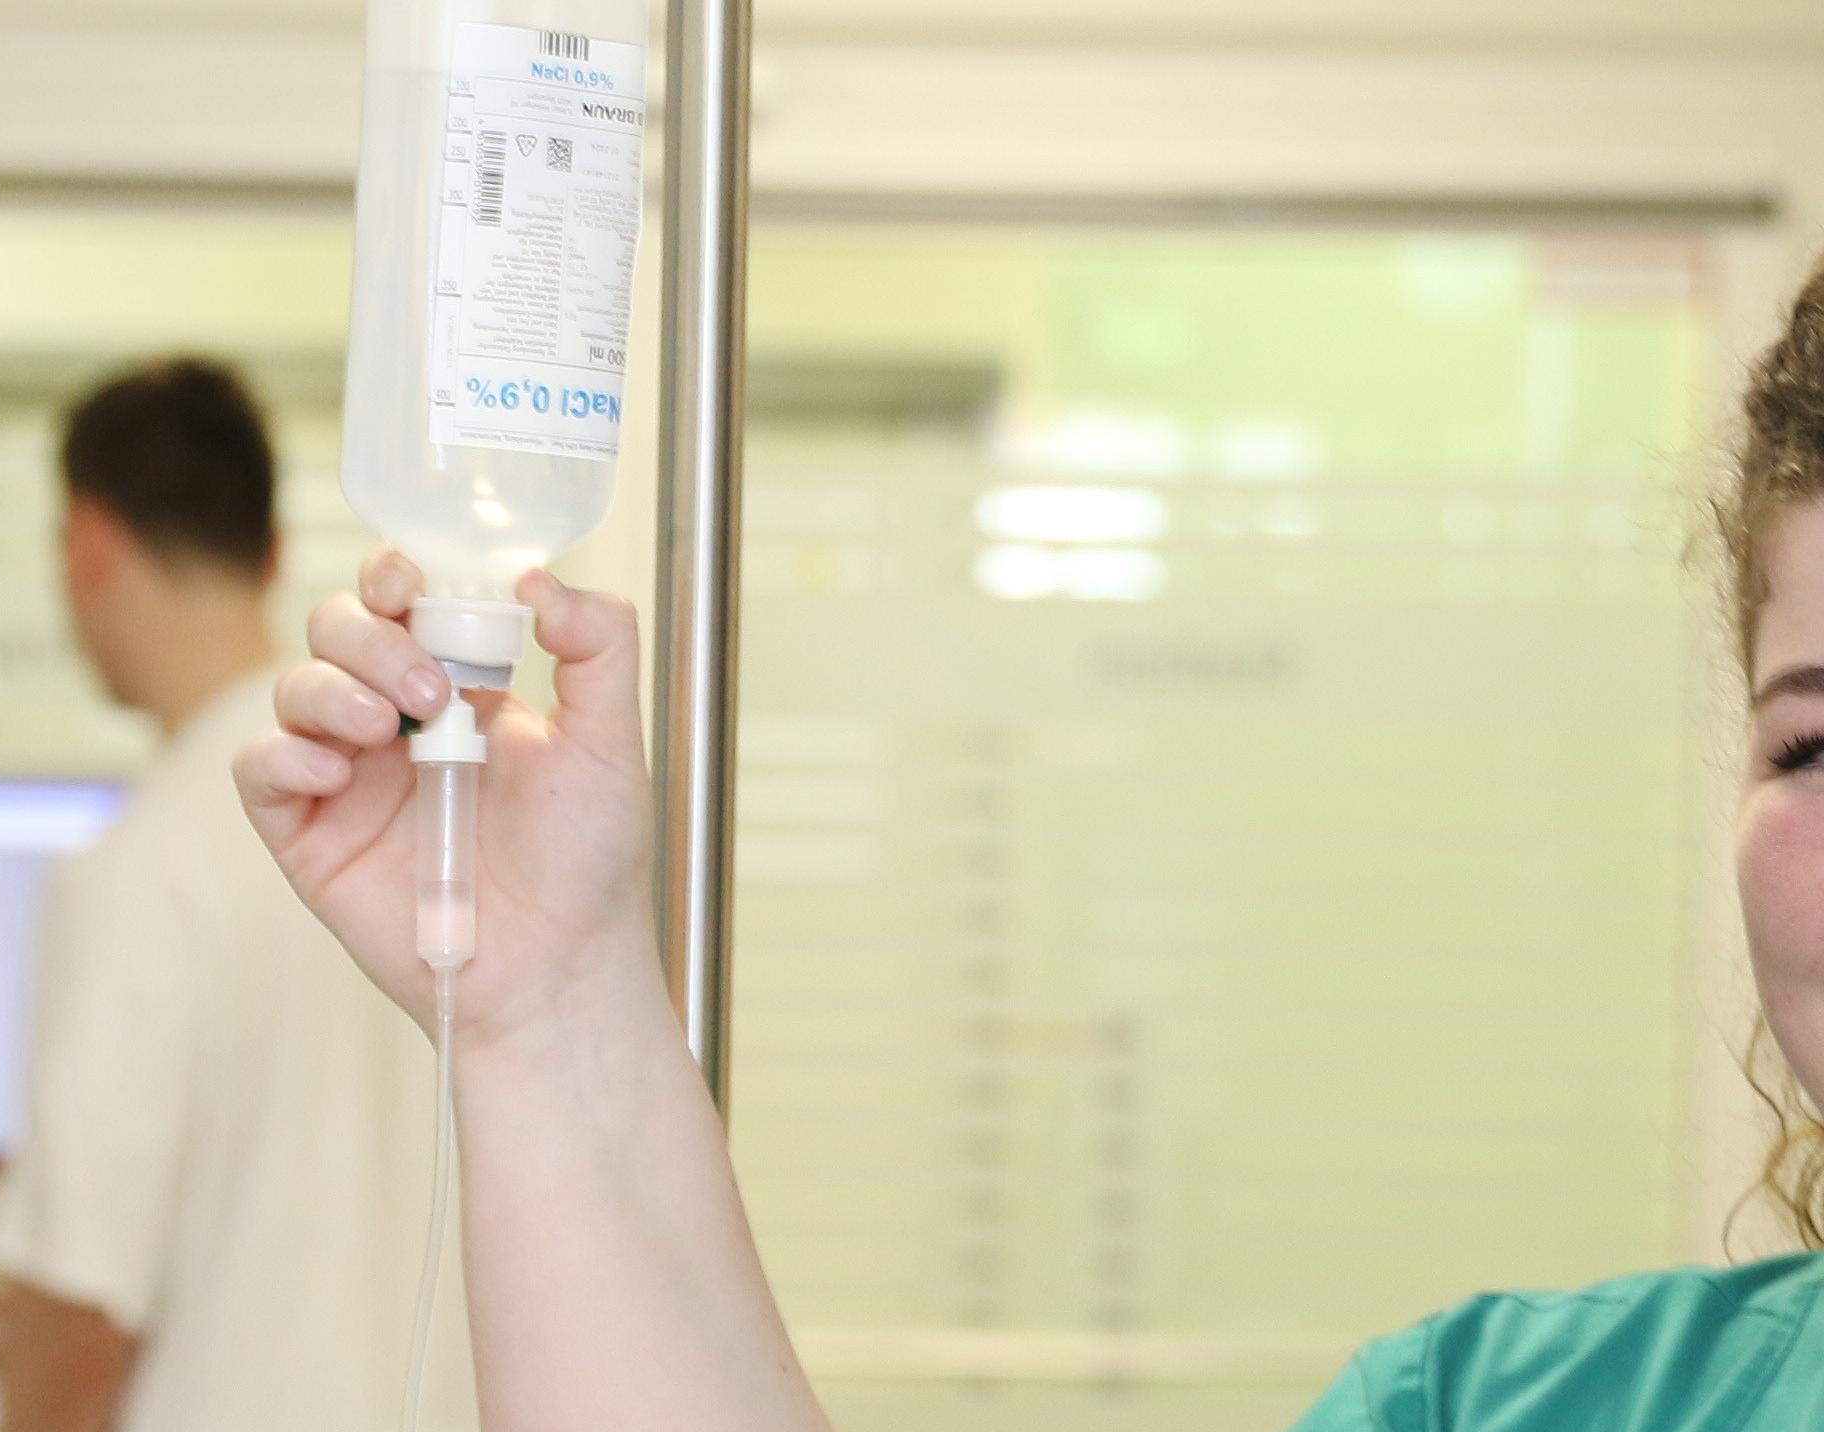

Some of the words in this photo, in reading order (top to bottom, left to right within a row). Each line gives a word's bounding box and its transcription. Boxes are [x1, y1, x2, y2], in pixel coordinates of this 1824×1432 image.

[531, 62, 569, 82] NaCl
[574, 70, 614, 90] 0,9%
[589, 346, 604, 363] ml
[466, 377, 551, 414] 0,9%
[560, 387, 621, 424] NaCl
